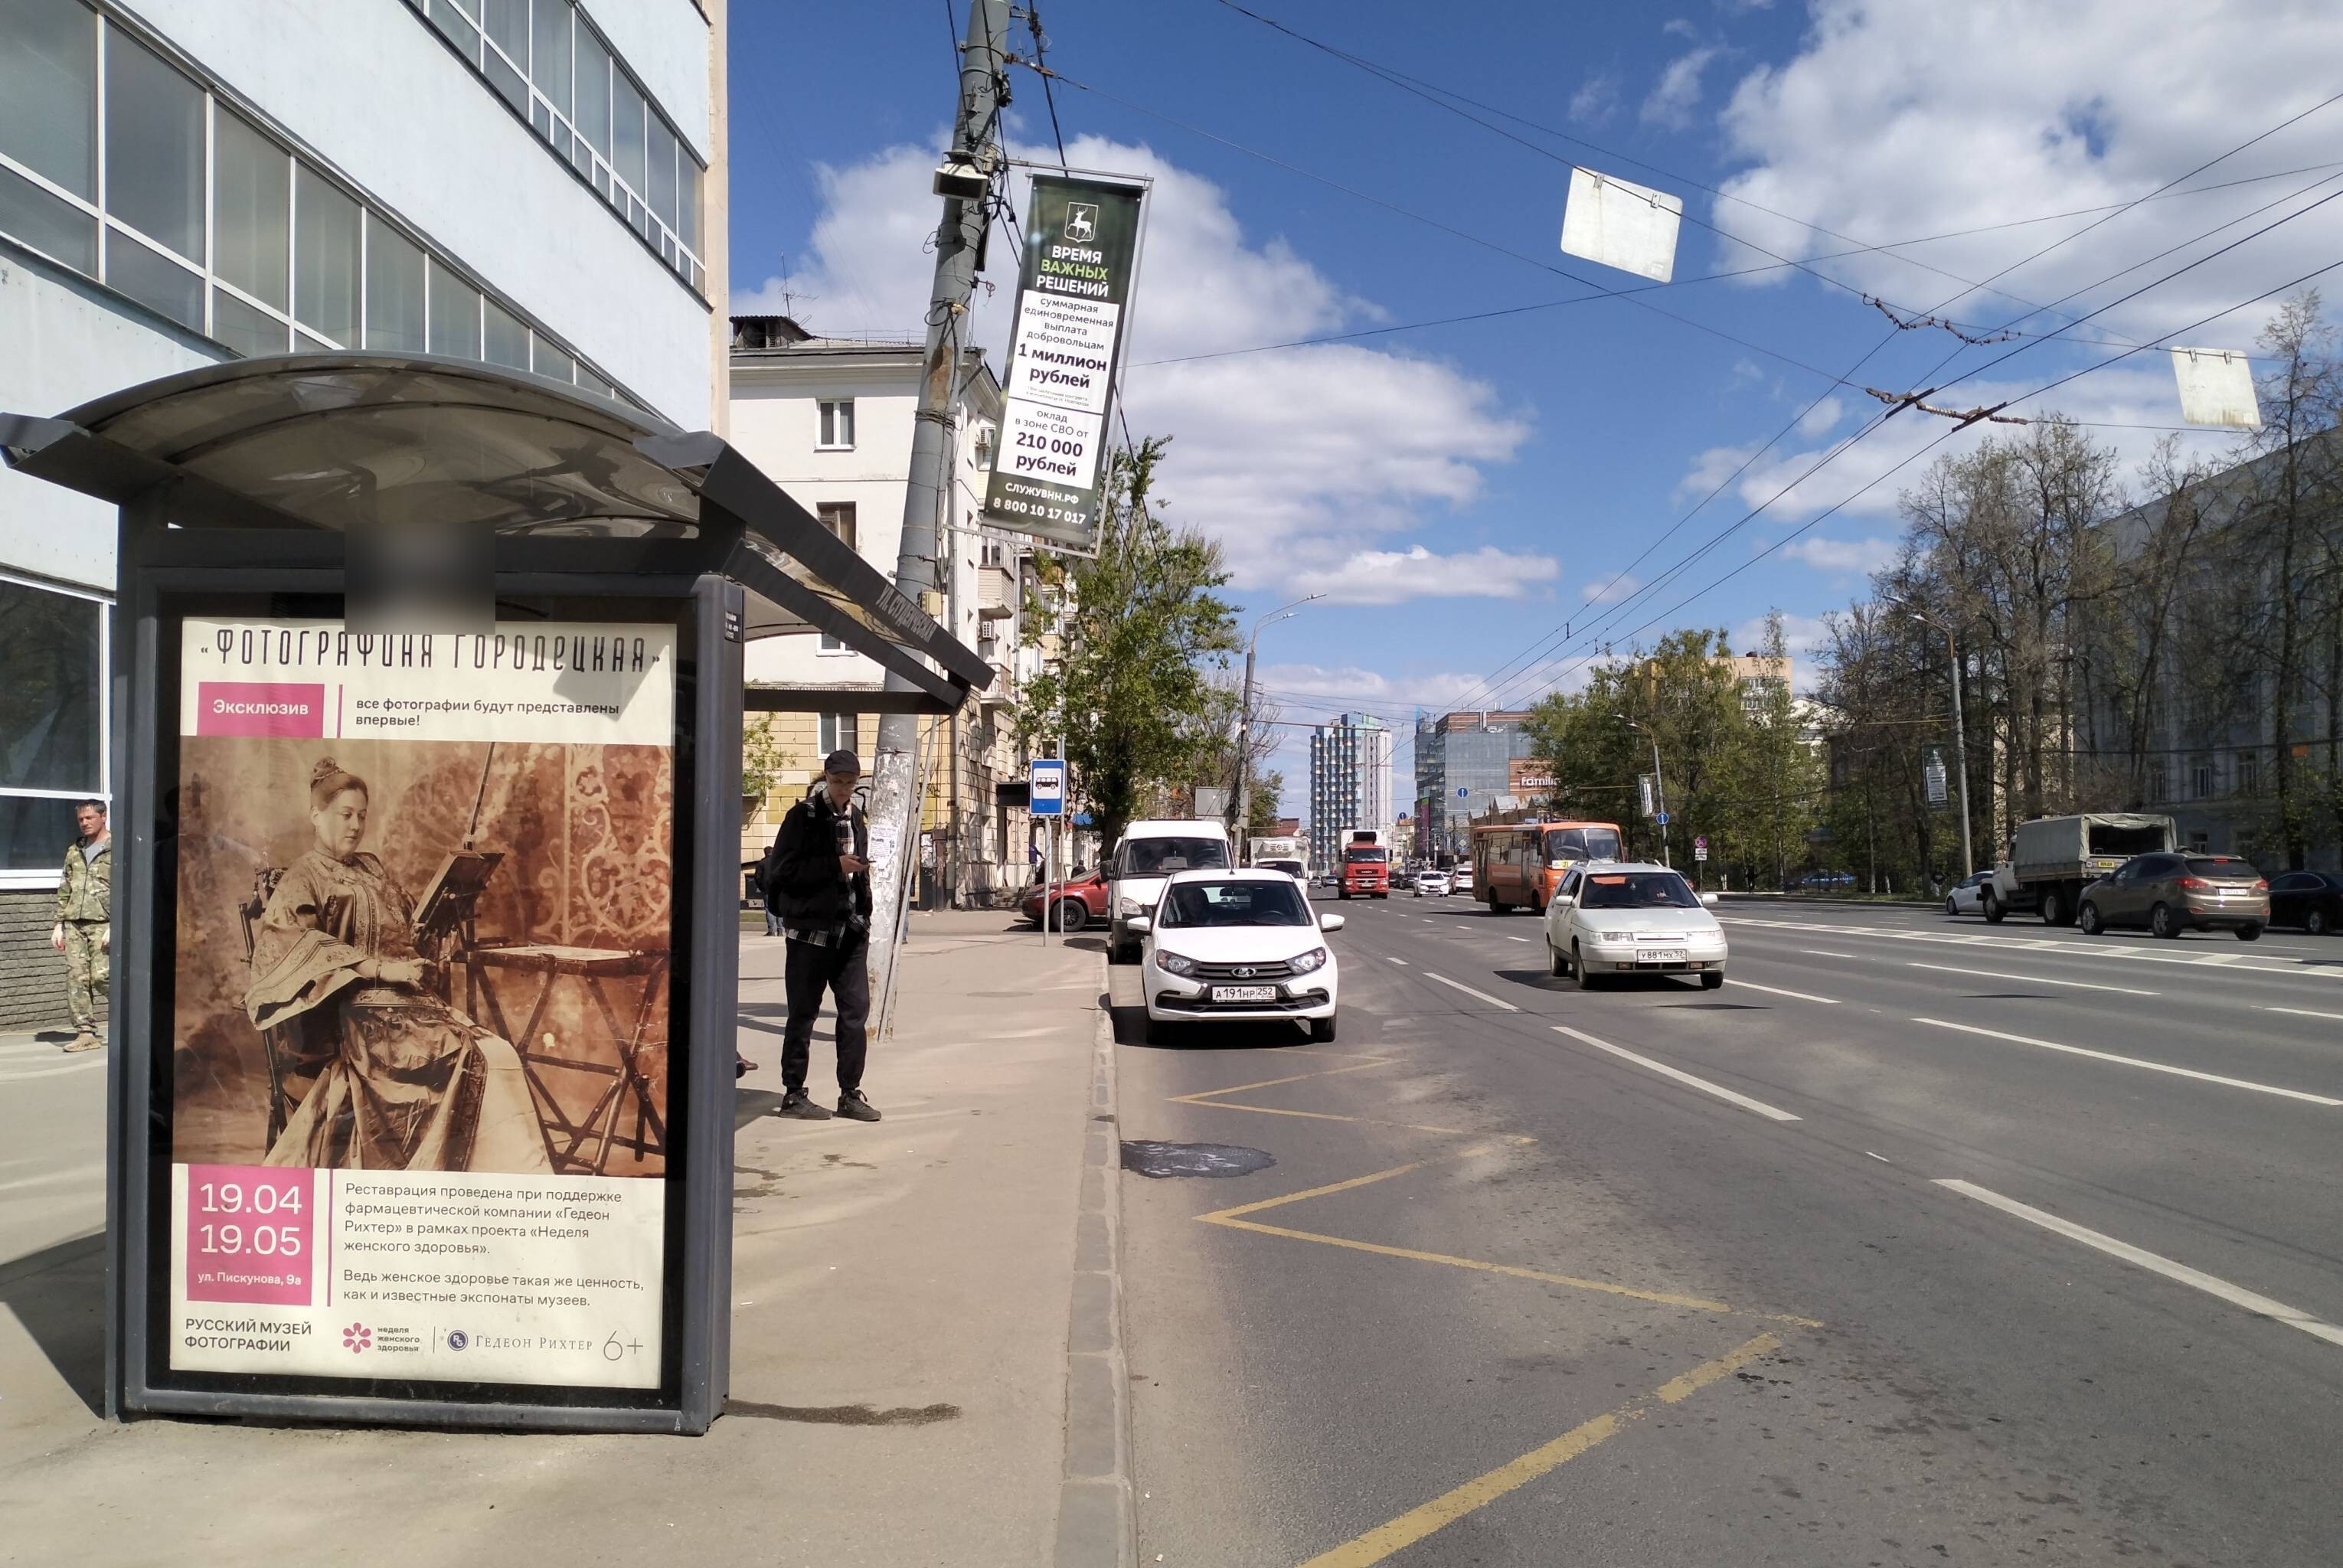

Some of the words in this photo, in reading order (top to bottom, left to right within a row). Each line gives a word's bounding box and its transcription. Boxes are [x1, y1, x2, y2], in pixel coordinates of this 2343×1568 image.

[1052, 245, 1103, 264] ВРЕМЯ
[1041, 259, 1109, 281] ВАЖНЫХ
[1036, 275, 1109, 297] РЕШЕНИЙ
[1040, 297, 1099, 314] суммарная
[1024, 306, 1114, 328] единовременная
[1044, 322, 1087, 335] выплата
[1026, 331, 1104, 351] добровольцам
[1018, 343, 1028, 357] 1
[1031, 349, 1107, 372] миллион
[1029, 368, 1090, 388] рублей
[1037, 410, 1068, 423] оклад
[1023, 419, 1048, 430] зоне
[1051, 423, 1074, 436] СВО
[1077, 430, 1089, 439] от
[1016, 432, 1047, 449] 210
[1051, 439, 1083, 457] 000
[1016, 455, 1077, 476] рублей
[1005, 482, 1080, 505] СЛУЖУВНН.РФ
[993, 498, 1001, 508] 8
[1004, 500, 1028, 514] 800
[1030, 504, 1044, 517] 10
[1047, 508, 1064, 520] 17
[1064, 511, 1087, 524] 017
[875, 583, 894, 611] УЛ.
[213, 699, 309, 715] Эксклюзив
[356, 700, 380, 709] все
[383, 698, 470, 713] фотографии
[473, 700, 513, 714] будут
[517, 703, 619, 714] представлены
[355, 714, 420, 727] впервые!
[1258, 987, 1273, 995] 252
[200, 1183, 302, 1215] 19.04
[345, 1183, 436, 1197] Реставрация
[440, 1187, 513, 1199] проведена
[516, 1190, 542, 1202] при
[546, 1191, 622, 1204] поддержке
[345, 1202, 480, 1216] фармацевтической
[483, 1208, 551, 1219] компании
[555, 1207, 609, 1221] «Гедеон
[345, 1220, 402, 1235] Рихтер»
[406, 1224, 413, 1233] в
[417, 1224, 469, 1236] рамках
[472, 1226, 526, 1237] проекта
[530, 1226, 589, 1239] «Неделя
[200, 1224, 301, 1256] 19.05
[344, 1242, 410, 1253] женского
[414, 1243, 490, 1255] здоровья».
[198, 1273, 214, 1284] ул.
[217, 1272, 284, 1286] Пискунова,
[286, 1275, 302, 1285] 9а
[344, 1269, 377, 1283] Ведь
[381, 1272, 441, 1283] женское
[444, 1274, 509, 1286] здоровье
[512, 1276, 550, 1286] такая
[554, 1277, 573, 1287] же
[577, 1279, 644, 1291] ценность,
[344, 1291, 367, 1300] как
[371, 1292, 378, 1300] и
[382, 1292, 456, 1302] известные
[459, 1292, 534, 1305] экспонаты
[538, 1296, 590, 1308] музеев.
[185, 1318, 257, 1333] РУССКИЙ
[260, 1321, 312, 1335] МУЗЕЙ
[185, 1335, 290, 1351] ФОТОГРАФИИ
[377, 1344, 419, 1353] здоровья
[603, 1331, 644, 1361] 6+
